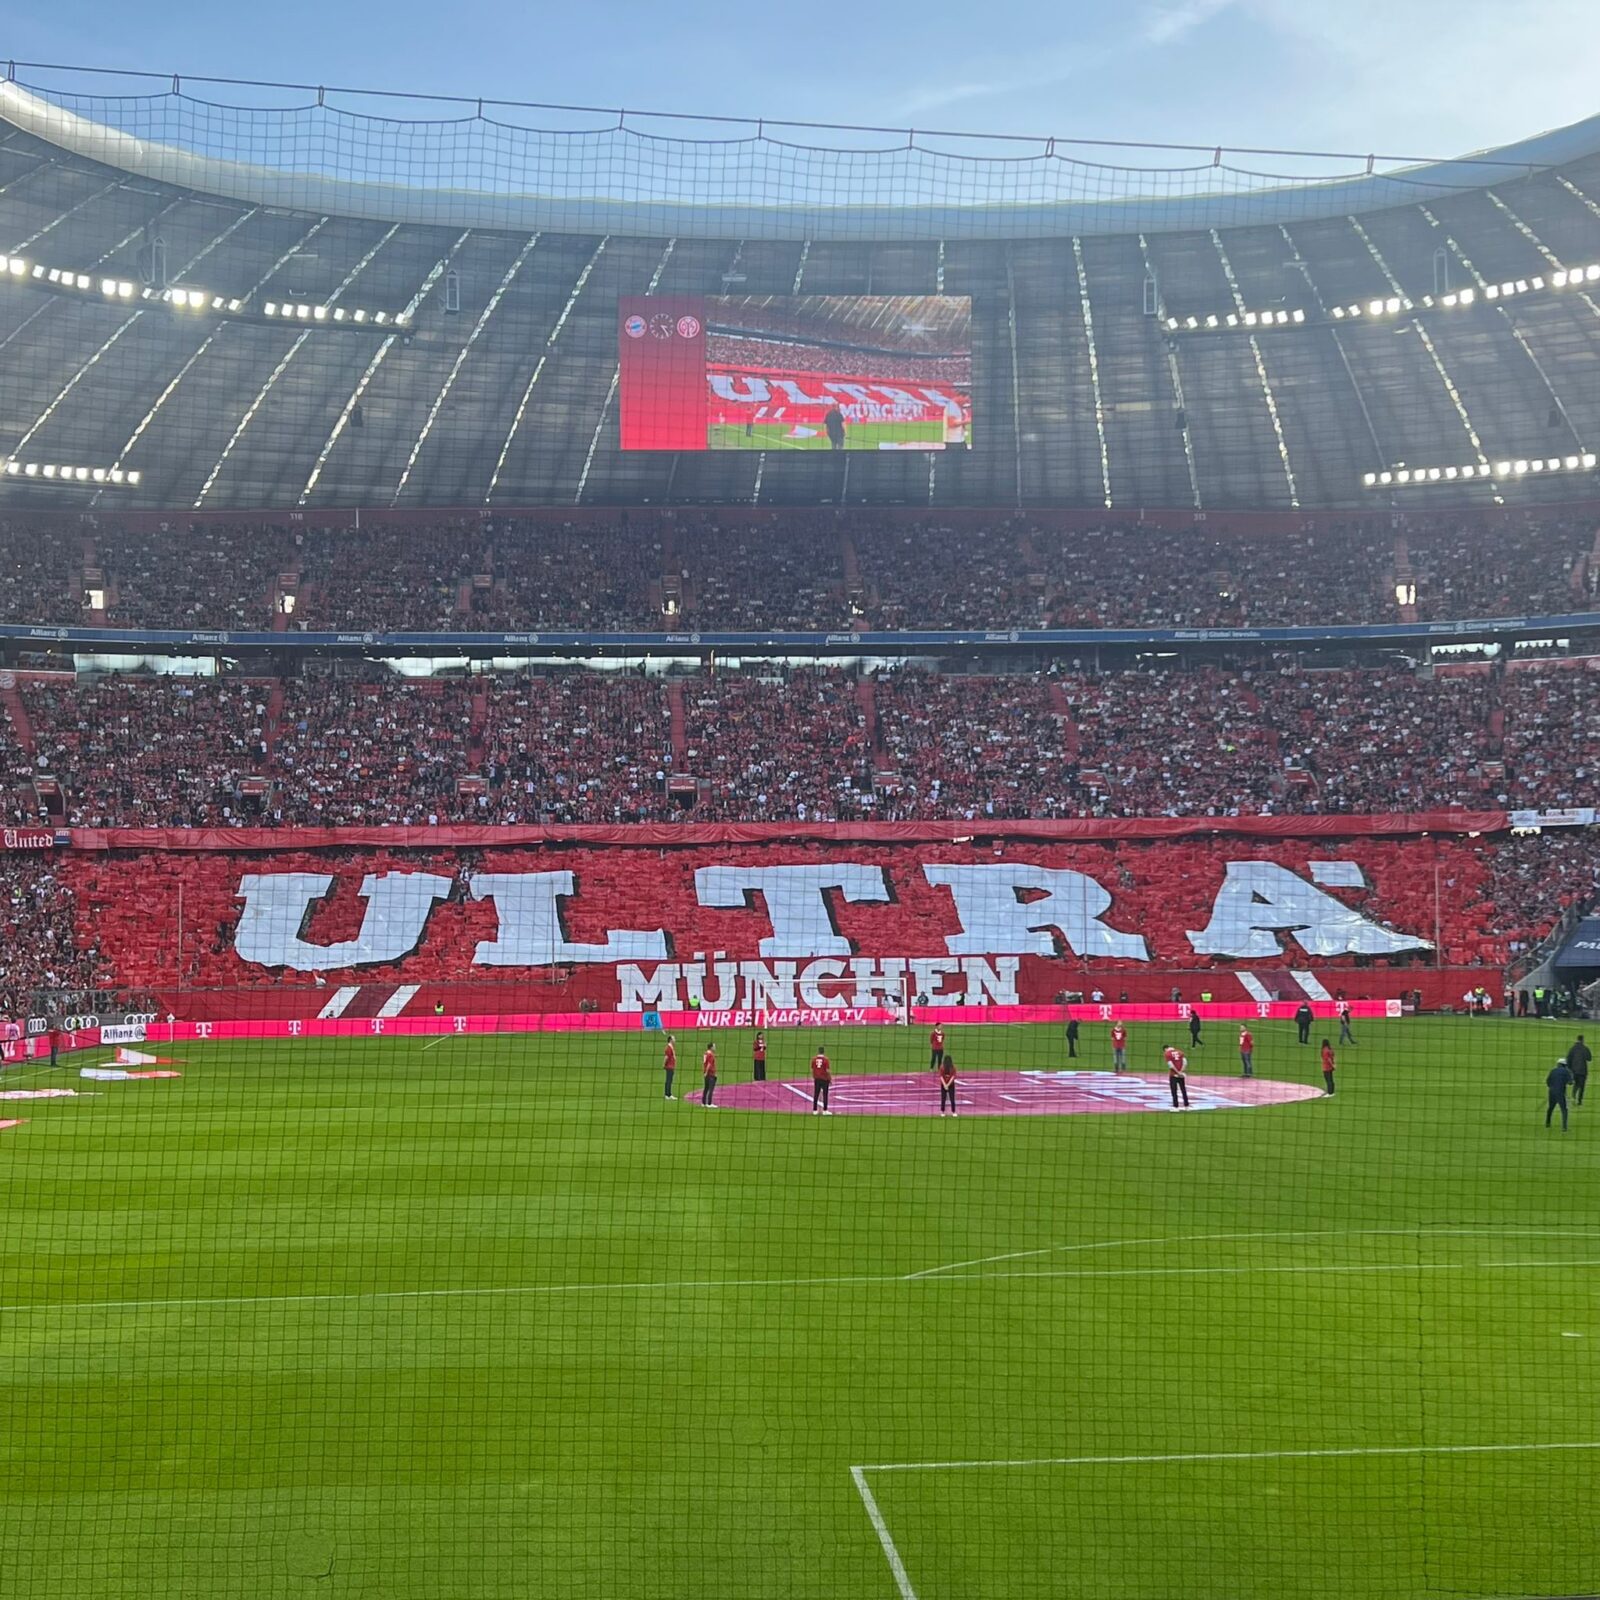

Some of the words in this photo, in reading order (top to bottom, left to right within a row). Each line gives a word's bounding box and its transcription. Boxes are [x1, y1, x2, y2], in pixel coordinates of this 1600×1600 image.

[30, 628, 57, 636] Allianz
[192, 633, 218, 641] Allianz
[337, 634, 362, 642] Allianz
[503, 634, 528, 642] Allianz
[665, 634, 689, 642] Allianz
[827, 634, 850, 642] Allianz
[985, 633, 1008, 641] Allianz
[4, 829, 53, 848] United
[616, 951, 1020, 1012] MÜNCHEN
[1100, 1004, 1112, 1020] T
[1178, 1003, 1191, 1018] T
[1257, 1002, 1270, 1017] T
[371, 1018, 385, 1034] T
[453, 1016, 467, 1032] T
[696, 1011, 731, 1026] NUR
[103, 1028, 133, 1040] Allianz
[195, 1021, 212, 1038] T
[288, 1020, 301, 1035] T
